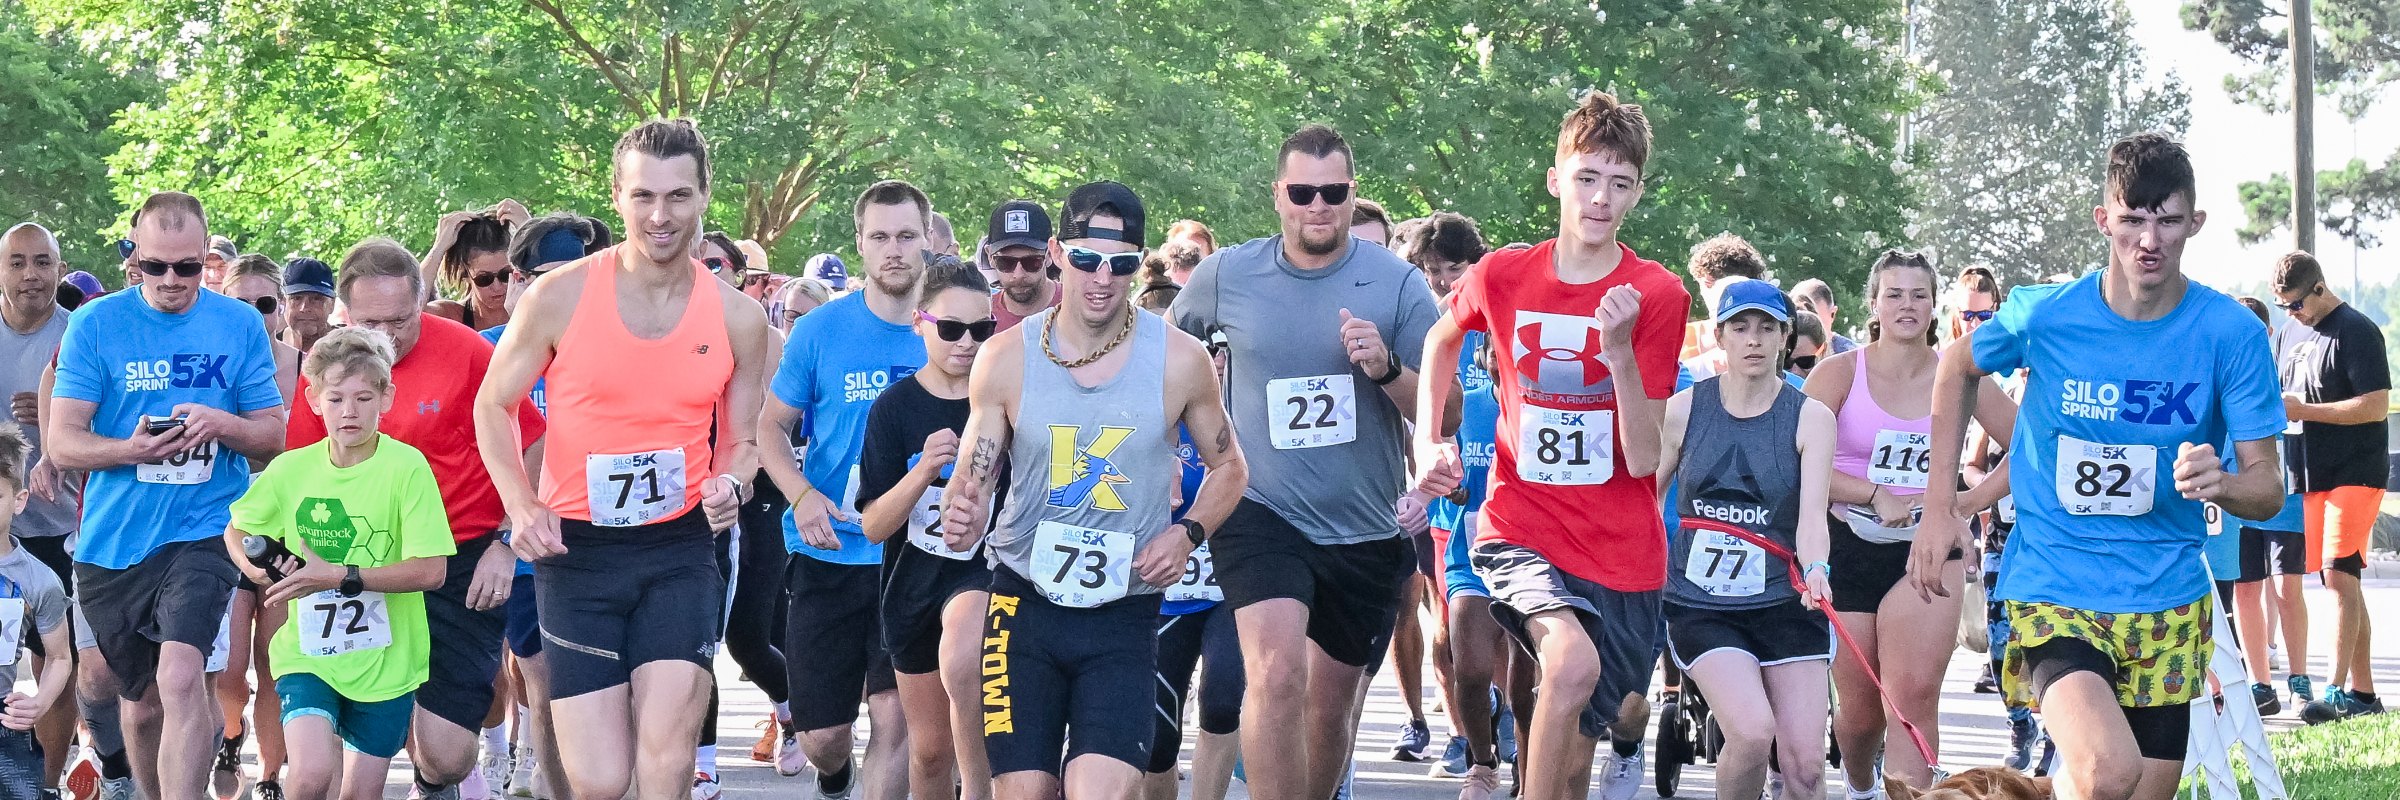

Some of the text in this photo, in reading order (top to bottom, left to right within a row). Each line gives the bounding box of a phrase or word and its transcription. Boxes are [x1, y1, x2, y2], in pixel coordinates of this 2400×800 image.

[126, 360, 170, 380] SILO
[171, 353, 229, 389] 5K
[126, 378, 169, 392] SPRINT
[844, 370, 888, 391] SILO
[1307, 378, 1329, 391] 5K
[845, 388, 886, 403] SPRIN
[1518, 388, 1614, 404] UNDER ARMOUR
[2061, 379, 2120, 406] SILO
[2061, 401, 2119, 421] SPRINT
[2120, 380, 2201, 426] 5K
[1287, 394, 1337, 430] 22
[1561, 413, 1585, 426] 5K
[1291, 438, 1306, 446] 5K
[1537, 428, 1590, 465] 81
[1909, 434, 1927, 445] 5K
[633, 453, 657, 467] 5K
[1466, 456, 1492, 466] SPRIN
[1875, 445, 1930, 473] 116
[2102, 447, 2127, 459] 5K
[1538, 472, 1553, 482] 5K
[2075, 461, 2131, 497] 82
[609, 468, 665, 509] 71
[1693, 500, 1769, 525] Reebok
[2076, 505, 2092, 513] 5K
[615, 517, 631, 525] 5K
[1081, 530, 1107, 547] 5K
[924, 543, 937, 553] 5K
[1053, 544, 1108, 589] 73
[1705, 547, 1747, 580] 77
[1048, 592, 1064, 603] 5K
[314, 600, 369, 638] 72
[322, 646, 337, 655] 5K
[982, 593, 1020, 737] K-TOWN
